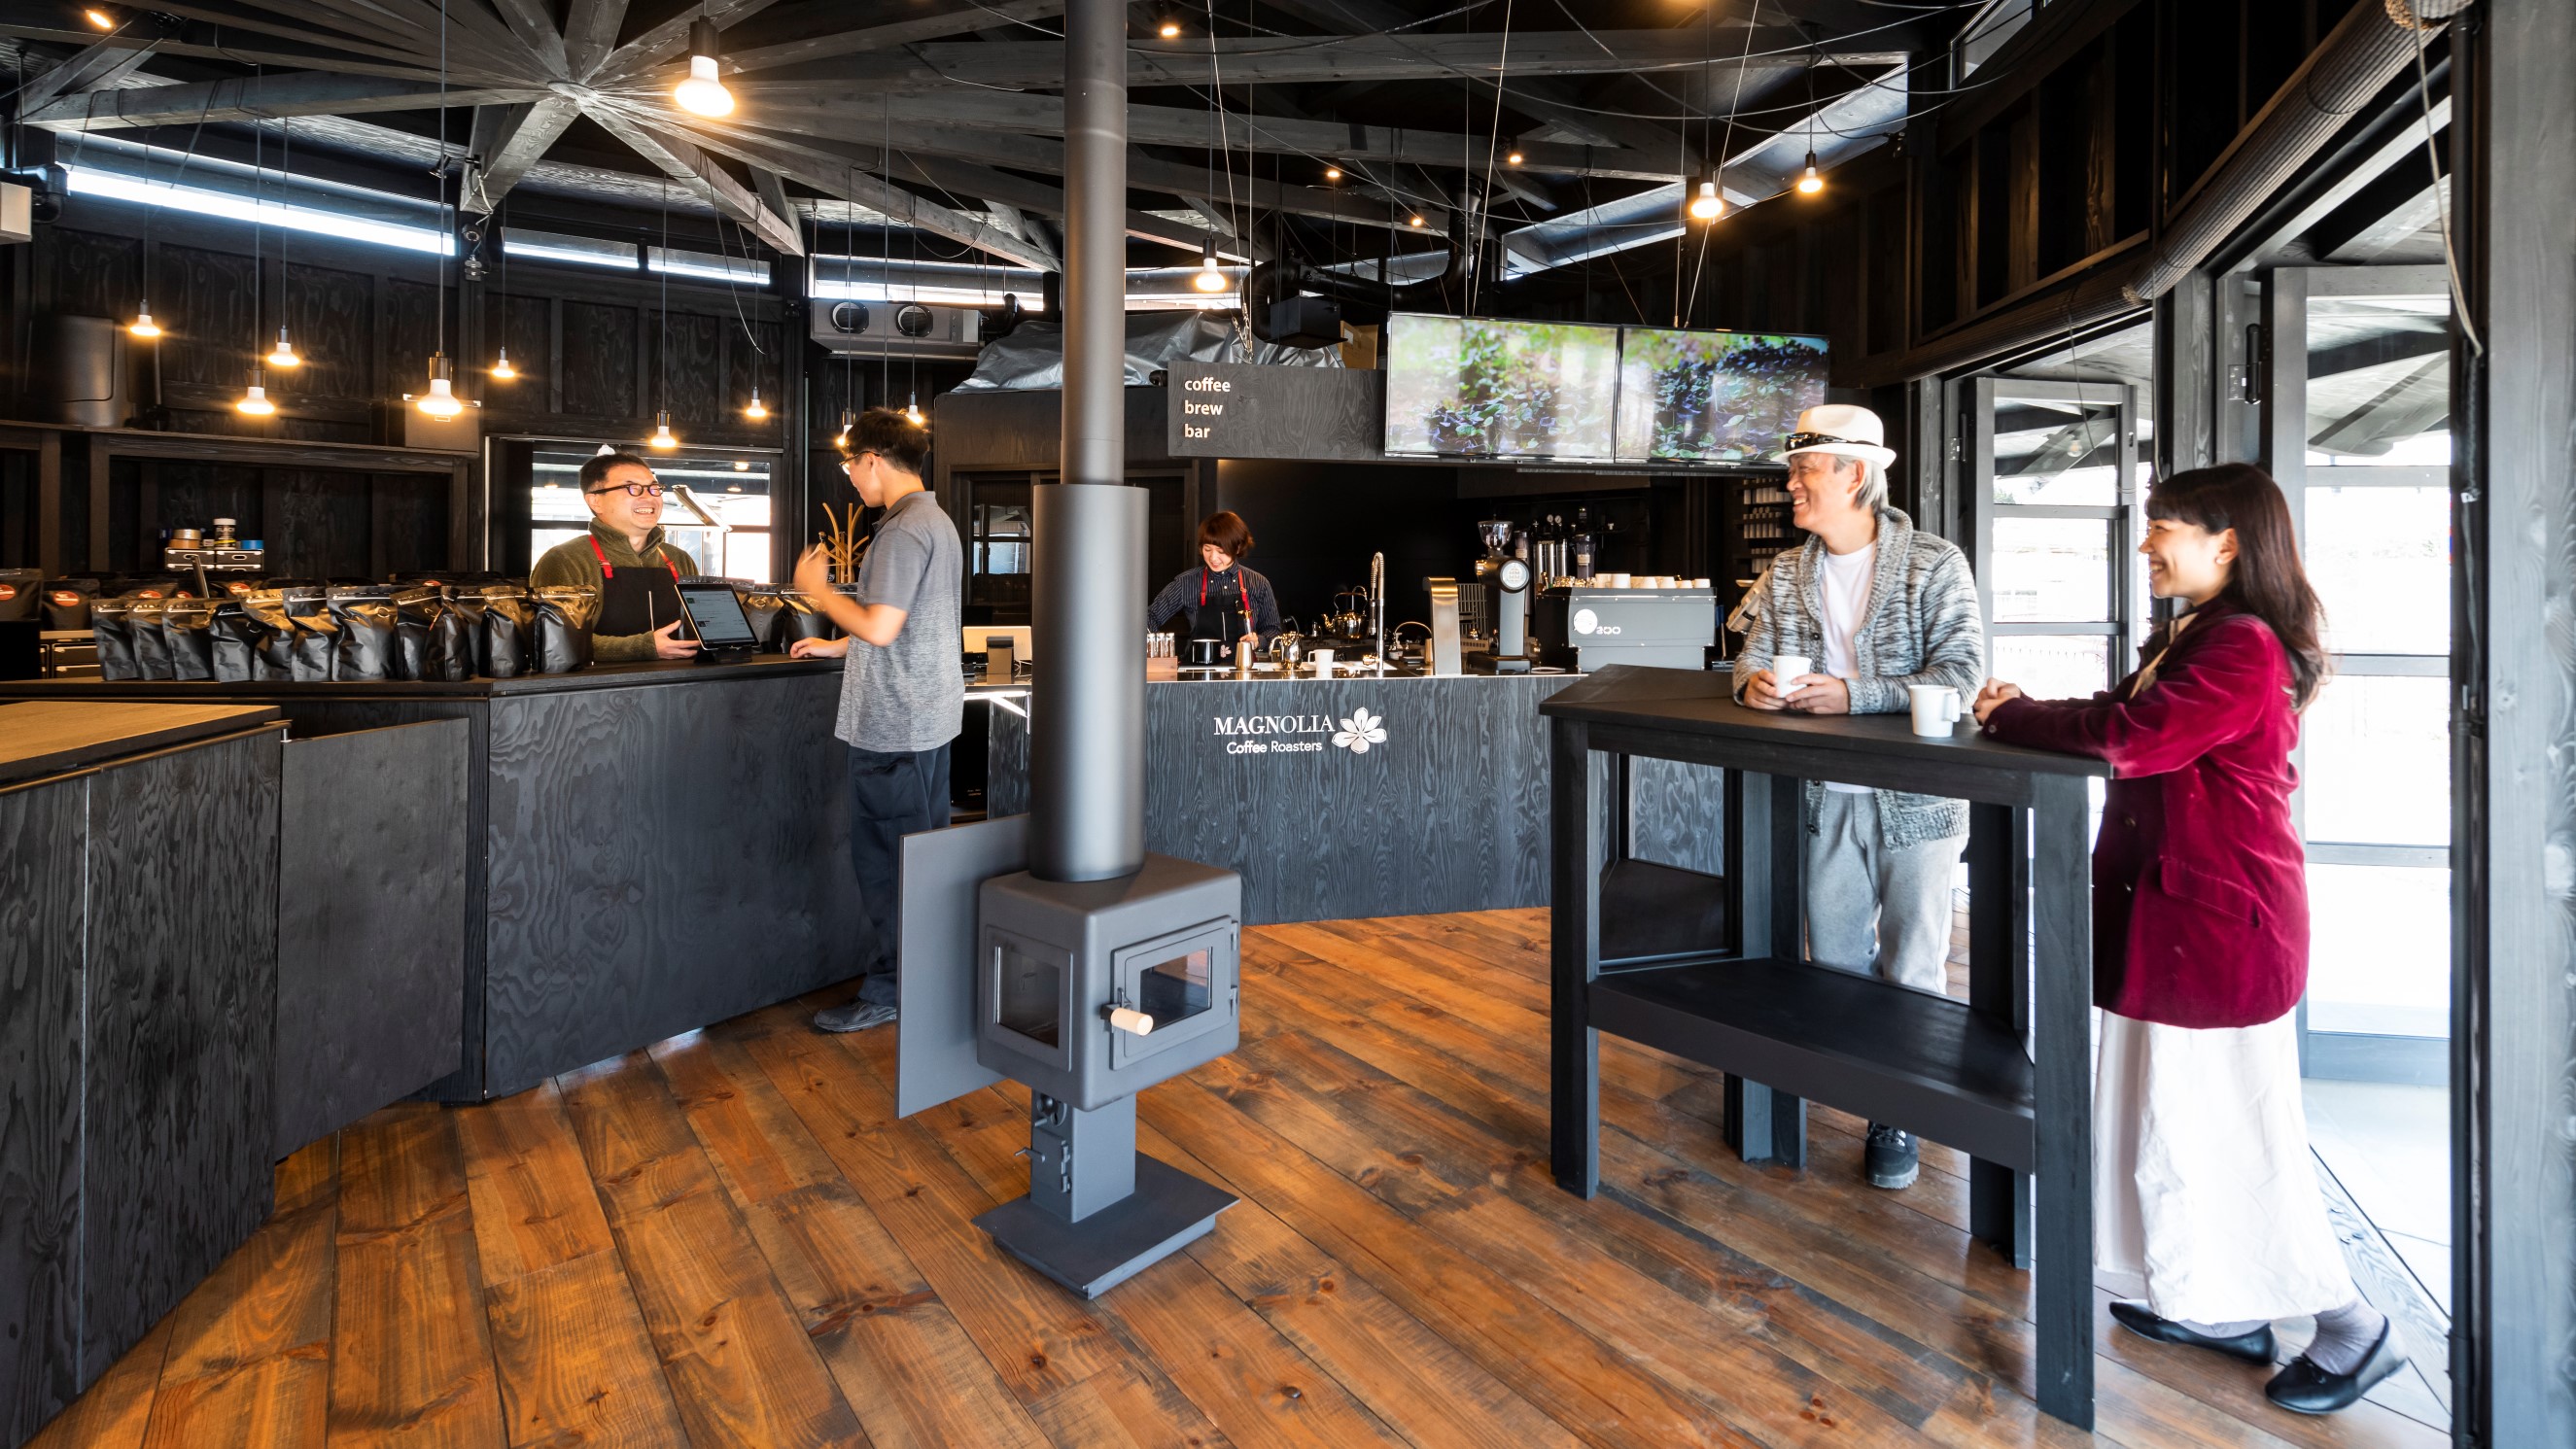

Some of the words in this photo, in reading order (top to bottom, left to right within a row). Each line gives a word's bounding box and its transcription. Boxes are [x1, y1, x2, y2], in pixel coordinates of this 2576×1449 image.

[1184, 376, 1231, 393] coffee
[1184, 399, 1223, 416] brew
[1184, 423, 1211, 438] bar
[1213, 714, 1336, 736] MAGNOLIA
[1226, 741, 1268, 755] Coffee
[1271, 741, 1323, 753] Roasters
